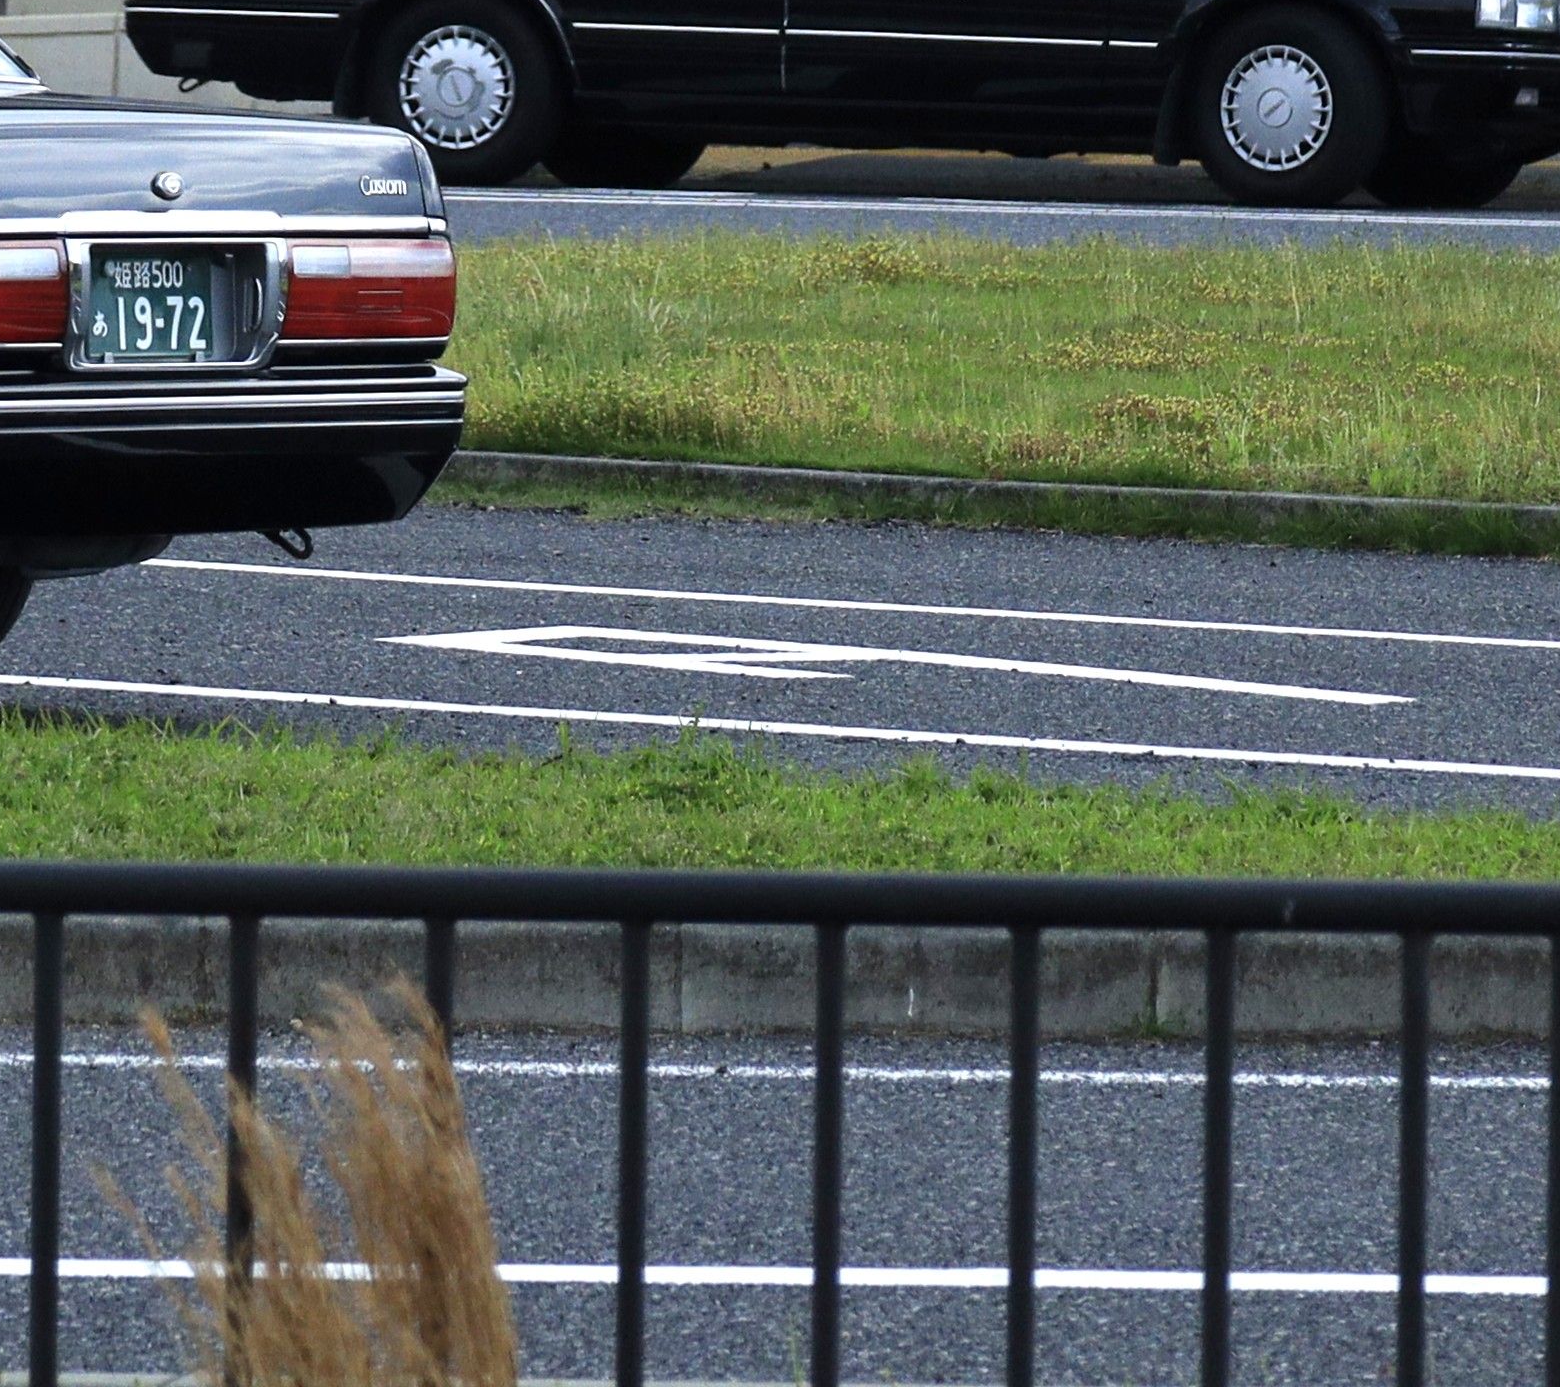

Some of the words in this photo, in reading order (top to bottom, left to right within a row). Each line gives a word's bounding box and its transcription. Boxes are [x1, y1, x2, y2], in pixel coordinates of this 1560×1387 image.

[360, 175, 407, 196] Custom
[92, 310, 108, 338] あ
[118, 296, 206, 350] 19-72
